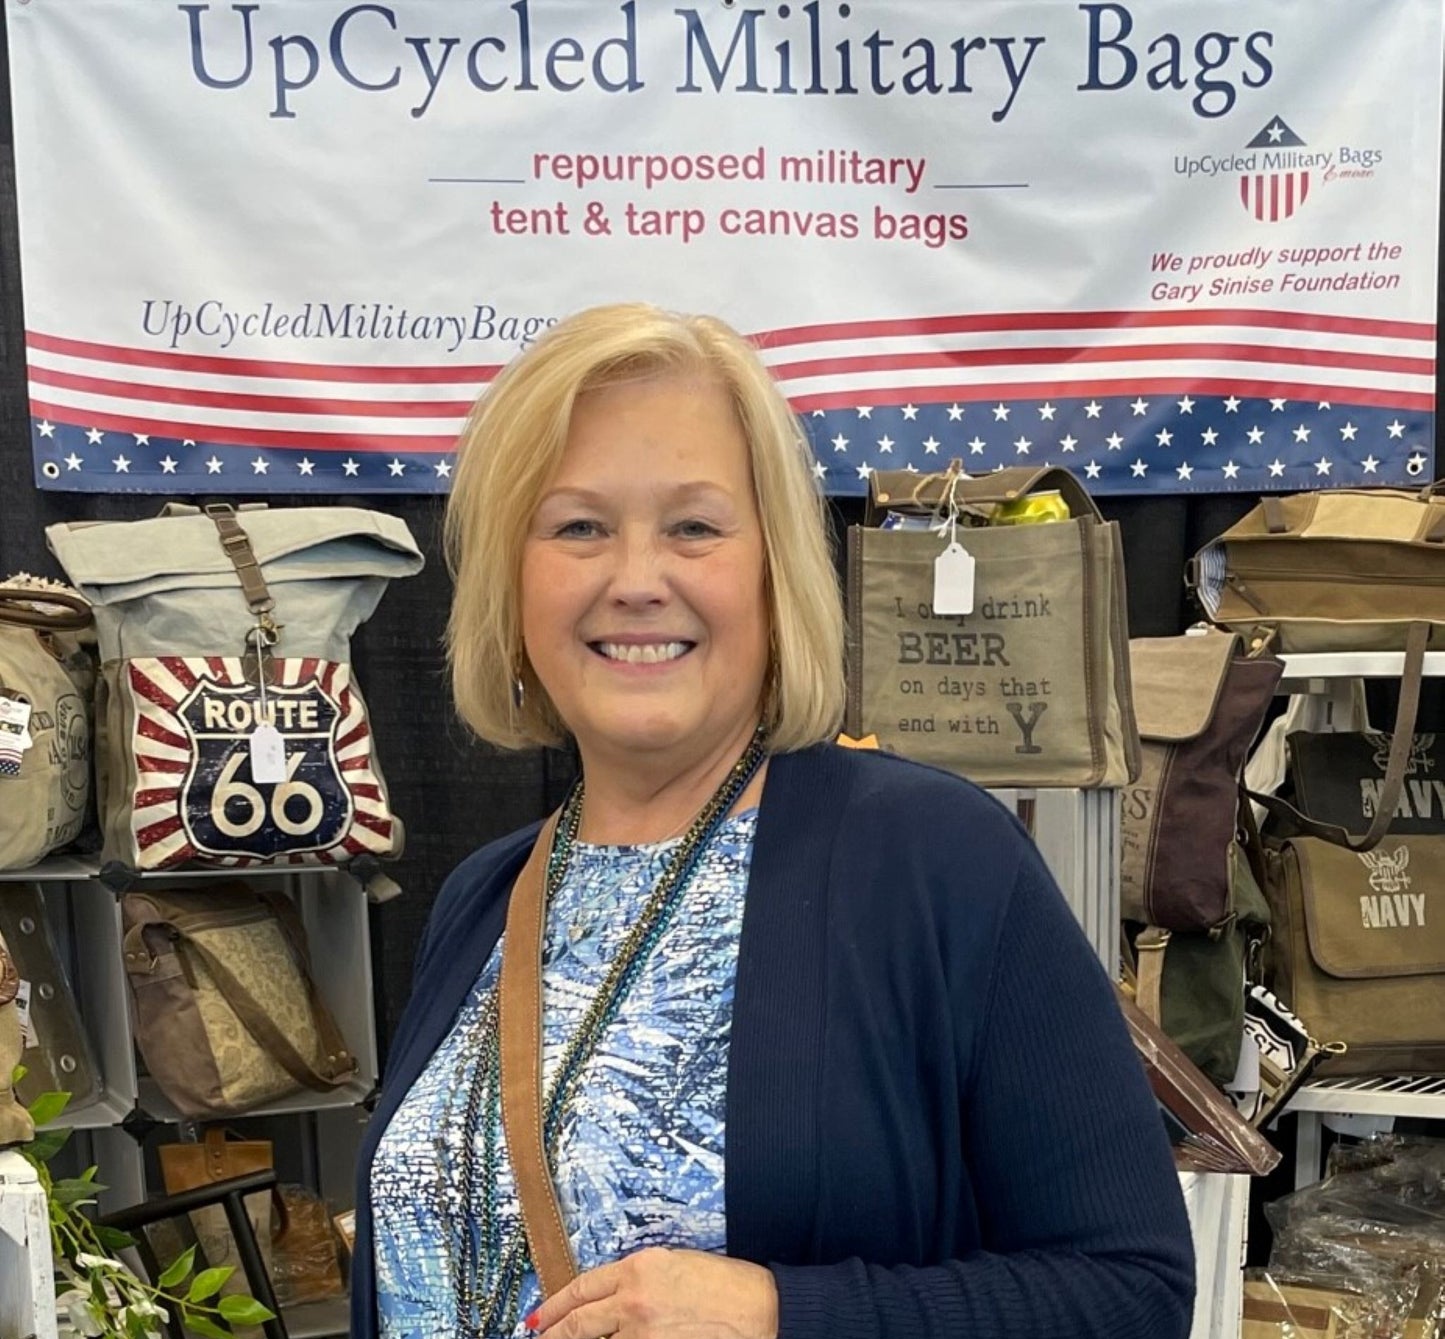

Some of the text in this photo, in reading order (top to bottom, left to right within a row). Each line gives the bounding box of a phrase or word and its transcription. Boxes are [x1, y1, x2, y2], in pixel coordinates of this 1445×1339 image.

[178, 0, 1275, 122] UpCycled Military Bags
[532, 146, 926, 193] repurposed military
[1174, 146, 1383, 178] UpCycled Military Bags
[490, 200, 969, 248] tent & tarp canvas bags
[1151, 241, 1402, 275] We proudly support the
[1151, 271, 1401, 303] Gary Sinise Foundation
[895, 596, 906, 618] I
[981, 594, 1052, 620] drink
[897, 632, 1010, 666] BEER
[900, 676, 1052, 701] on days that
[204, 699, 319, 729] ROUTE
[898, 702, 1048, 754] end with Y
[211, 751, 323, 838] 66
[1360, 893, 1426, 929] NAVY
